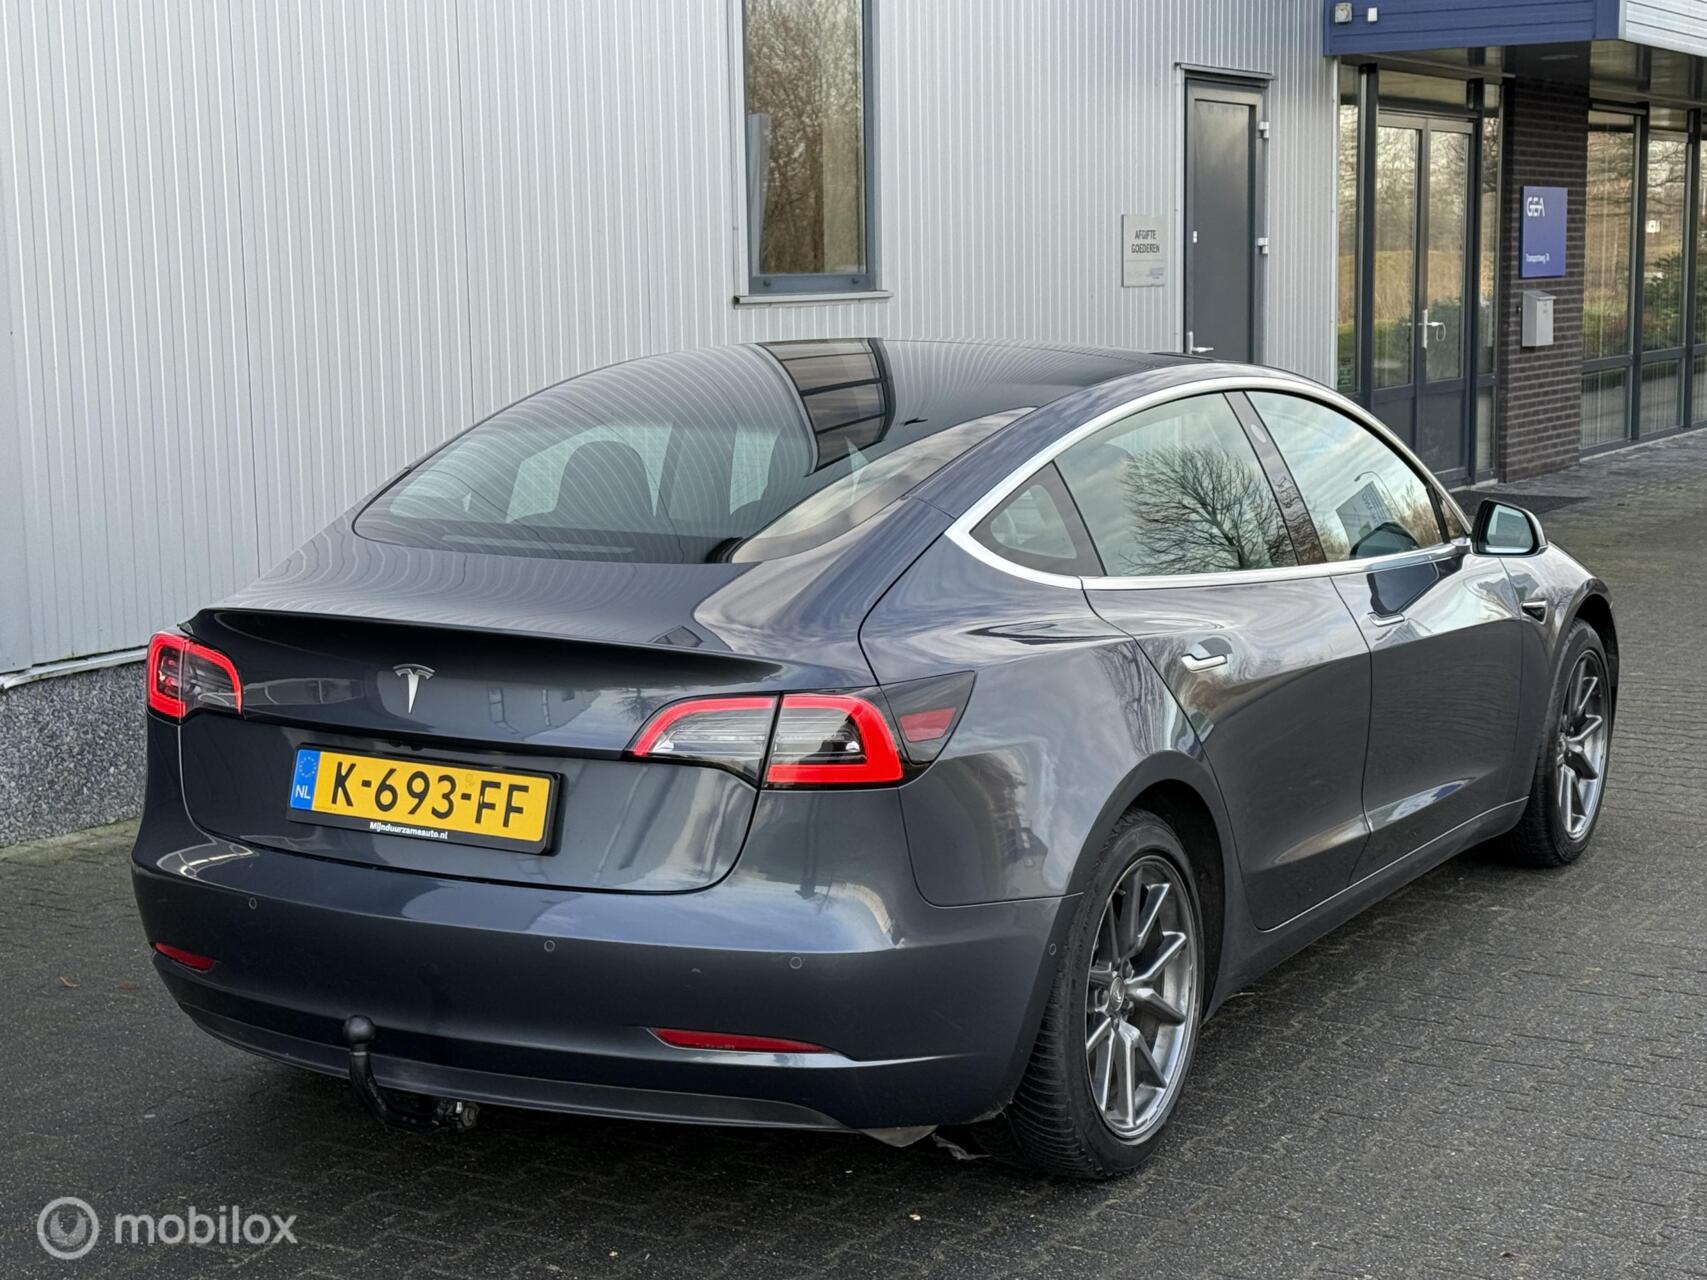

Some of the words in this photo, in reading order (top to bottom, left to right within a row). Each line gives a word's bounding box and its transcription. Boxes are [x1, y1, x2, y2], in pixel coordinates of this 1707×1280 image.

[1526, 196, 1546, 217] GEA
[1134, 229, 1157, 240] AFGIFTE
[1130, 243, 1160, 254] GOEDEREN
[295, 784, 312, 801] NL
[330, 761, 530, 828] K-693-FF
[369, 820, 449, 840] Mijnduurzameauto.nl
